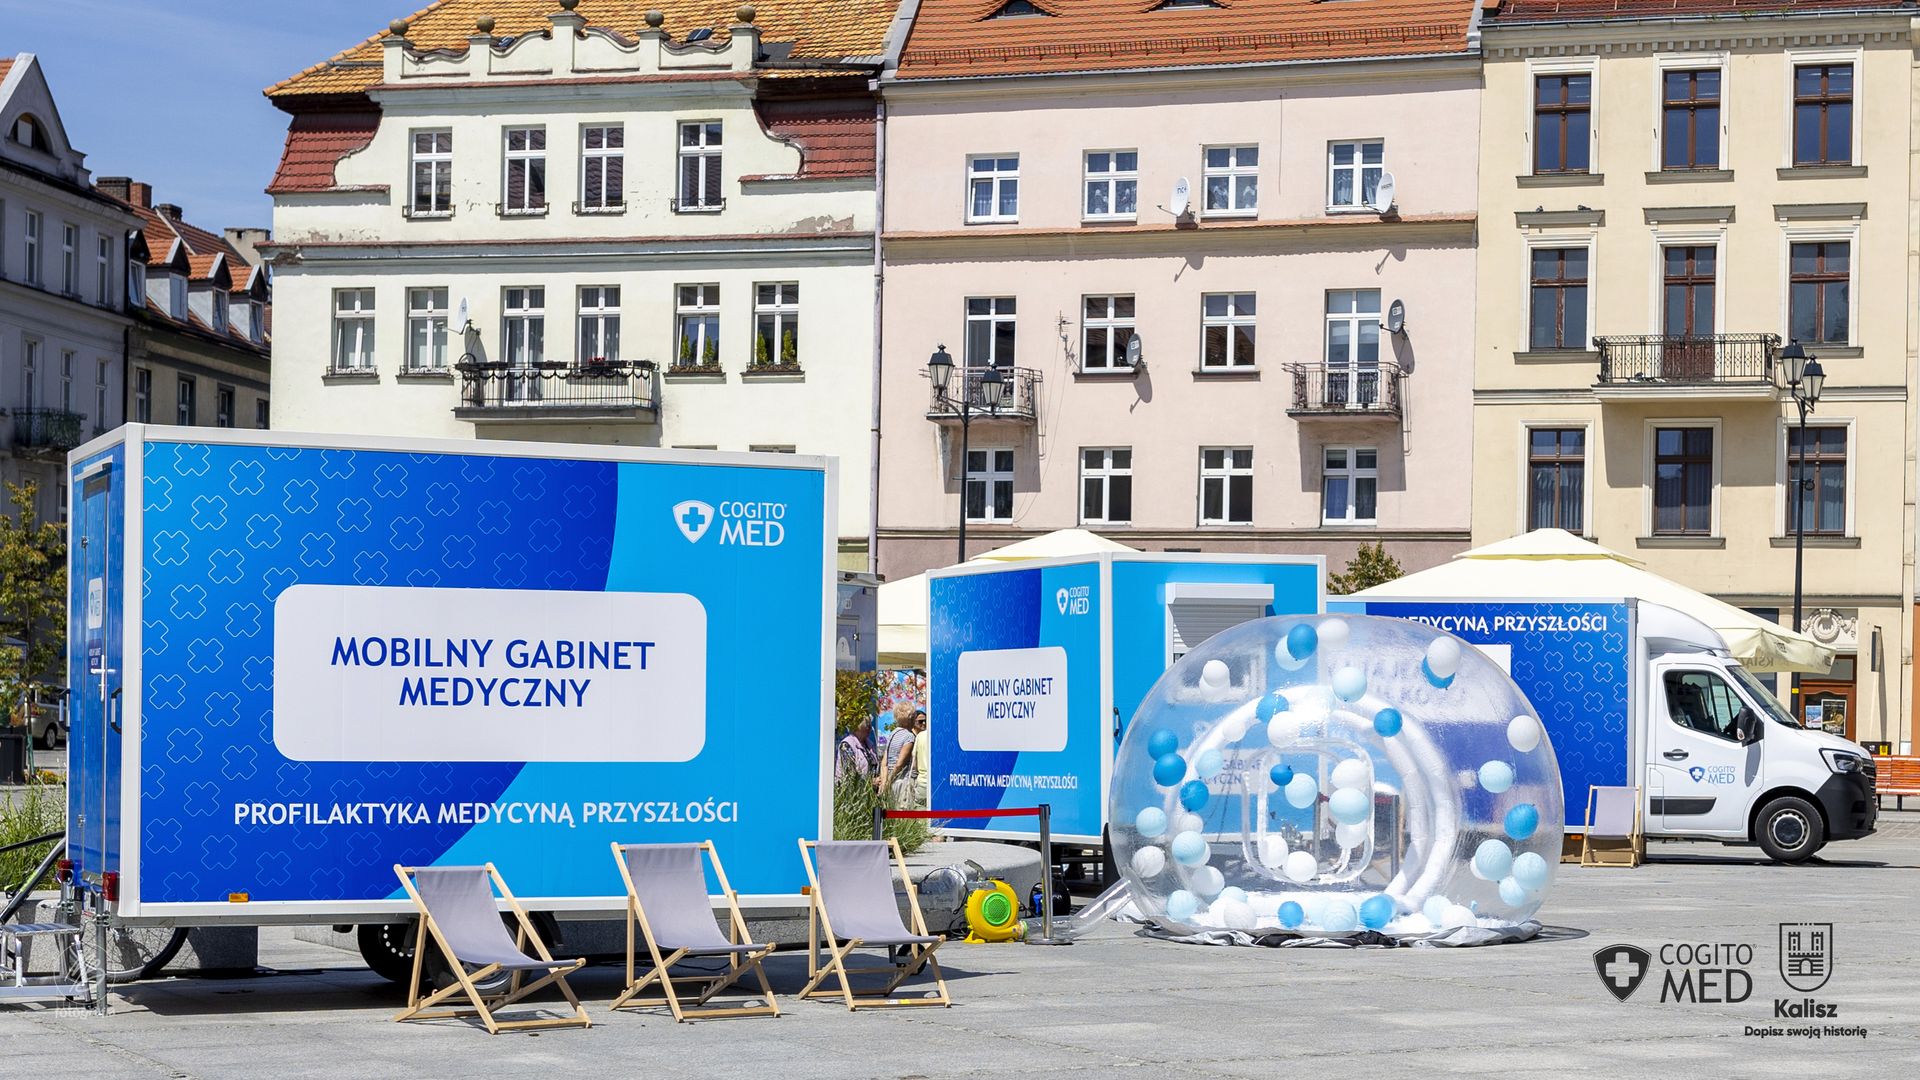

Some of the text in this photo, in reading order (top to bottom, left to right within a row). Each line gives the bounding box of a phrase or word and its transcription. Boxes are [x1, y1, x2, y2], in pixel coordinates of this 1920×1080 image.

[719, 501, 785, 519] COGITO
[719, 519, 785, 546] MED
[1070, 586, 1089, 598] COGITO
[1069, 598, 1090, 615] MED
[1396, 612, 1607, 634] DYCYNĄ PRZYSZŁOŚCI
[331, 637, 655, 670] MOBILNY GABINET
[399, 677, 591, 708] MEDYCZNY
[970, 677, 1053, 697] MOBILNY GABINET
[986, 701, 1036, 719] MEDYCZNY
[1707, 765, 1736, 773] COGITO
[1707, 773, 1736, 784] MED
[949, 772, 1078, 791] PROFILAKTYKA MEDYCYNĄ PRZYSZŁOŚCI
[234, 796, 738, 828] PROFILAKTYKA MEDYCYNĄ PRZYSZŁOŚCI
